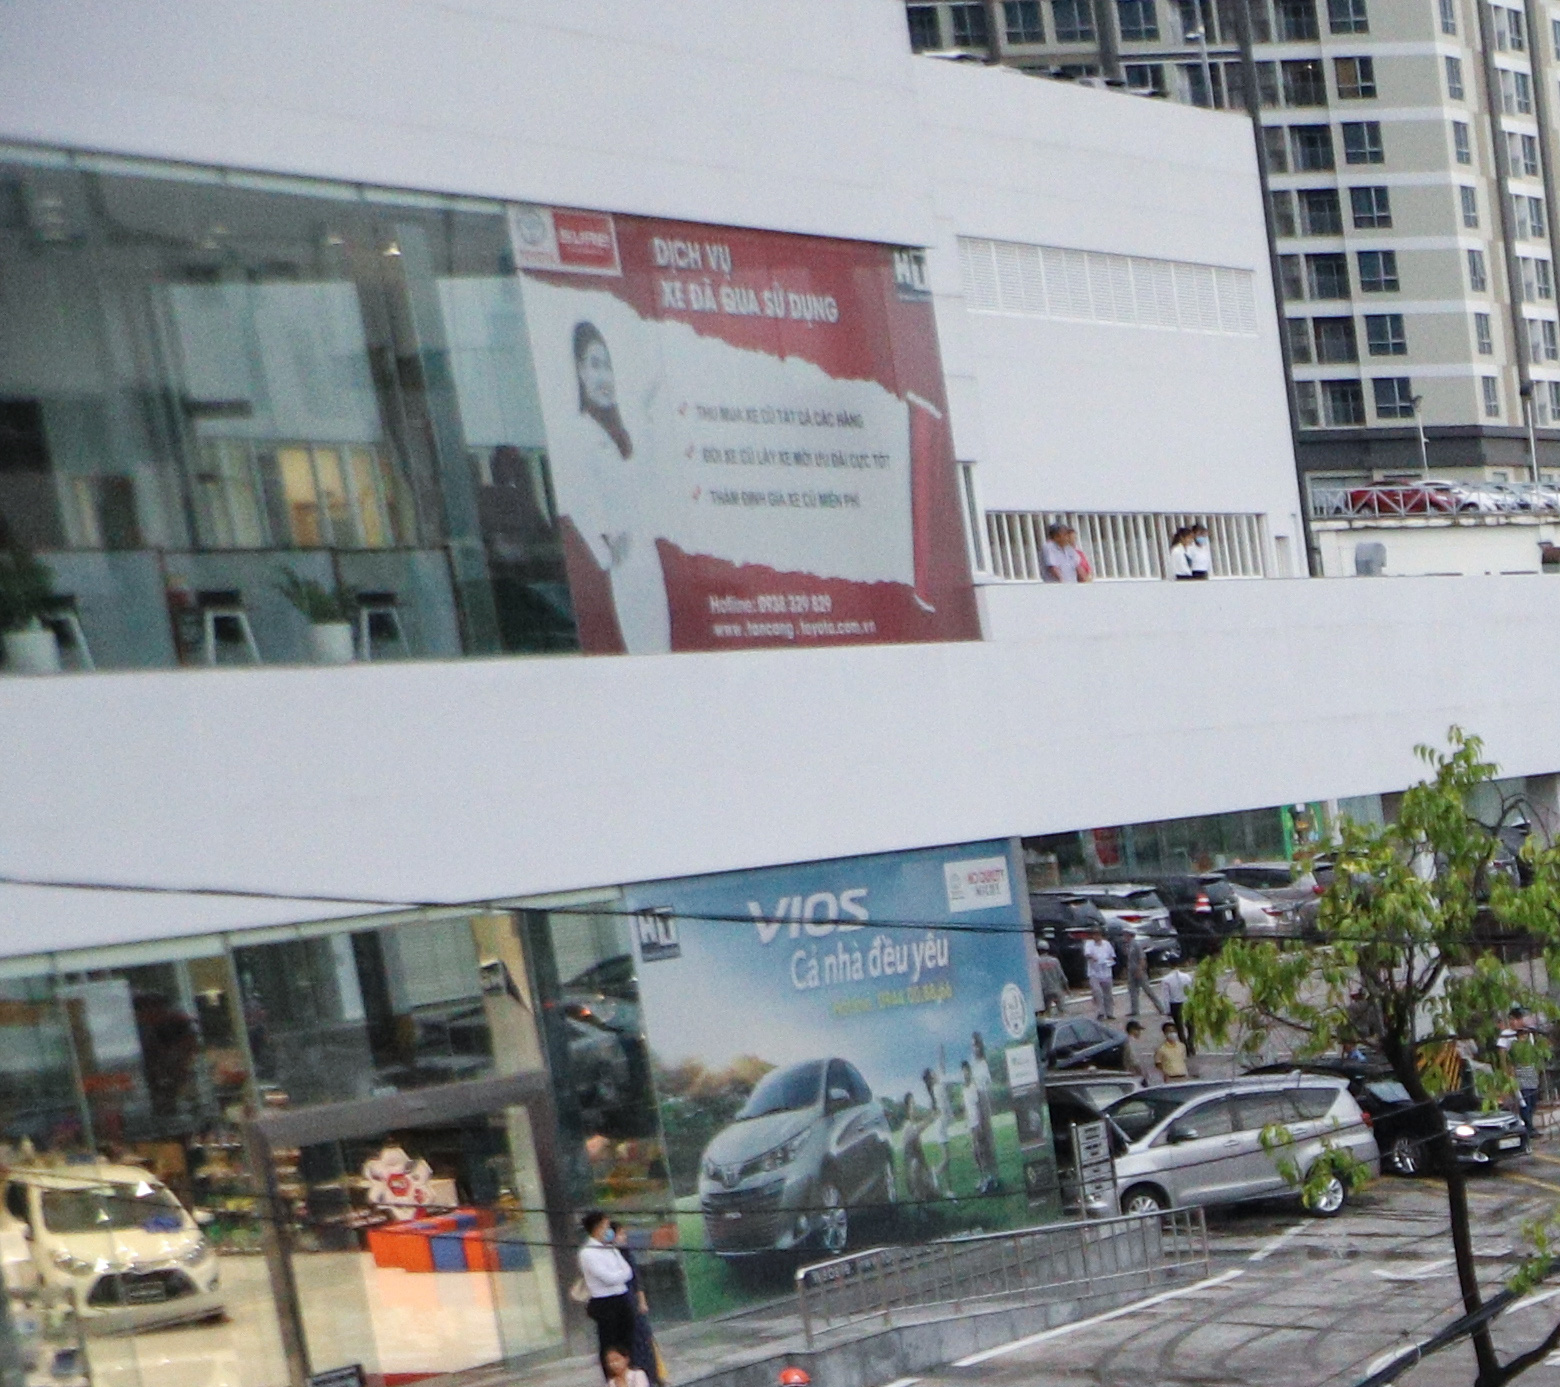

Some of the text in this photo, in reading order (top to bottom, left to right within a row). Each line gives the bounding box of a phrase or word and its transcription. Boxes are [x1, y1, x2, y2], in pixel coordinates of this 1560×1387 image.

[653, 237, 733, 280] DỊCH VỤ
[662, 278, 840, 329] XE ĐÃ QUA SỬ DỤNG
[747, 888, 869, 944] VIOS
[791, 931, 949, 990] Cả nhà đều yêu
